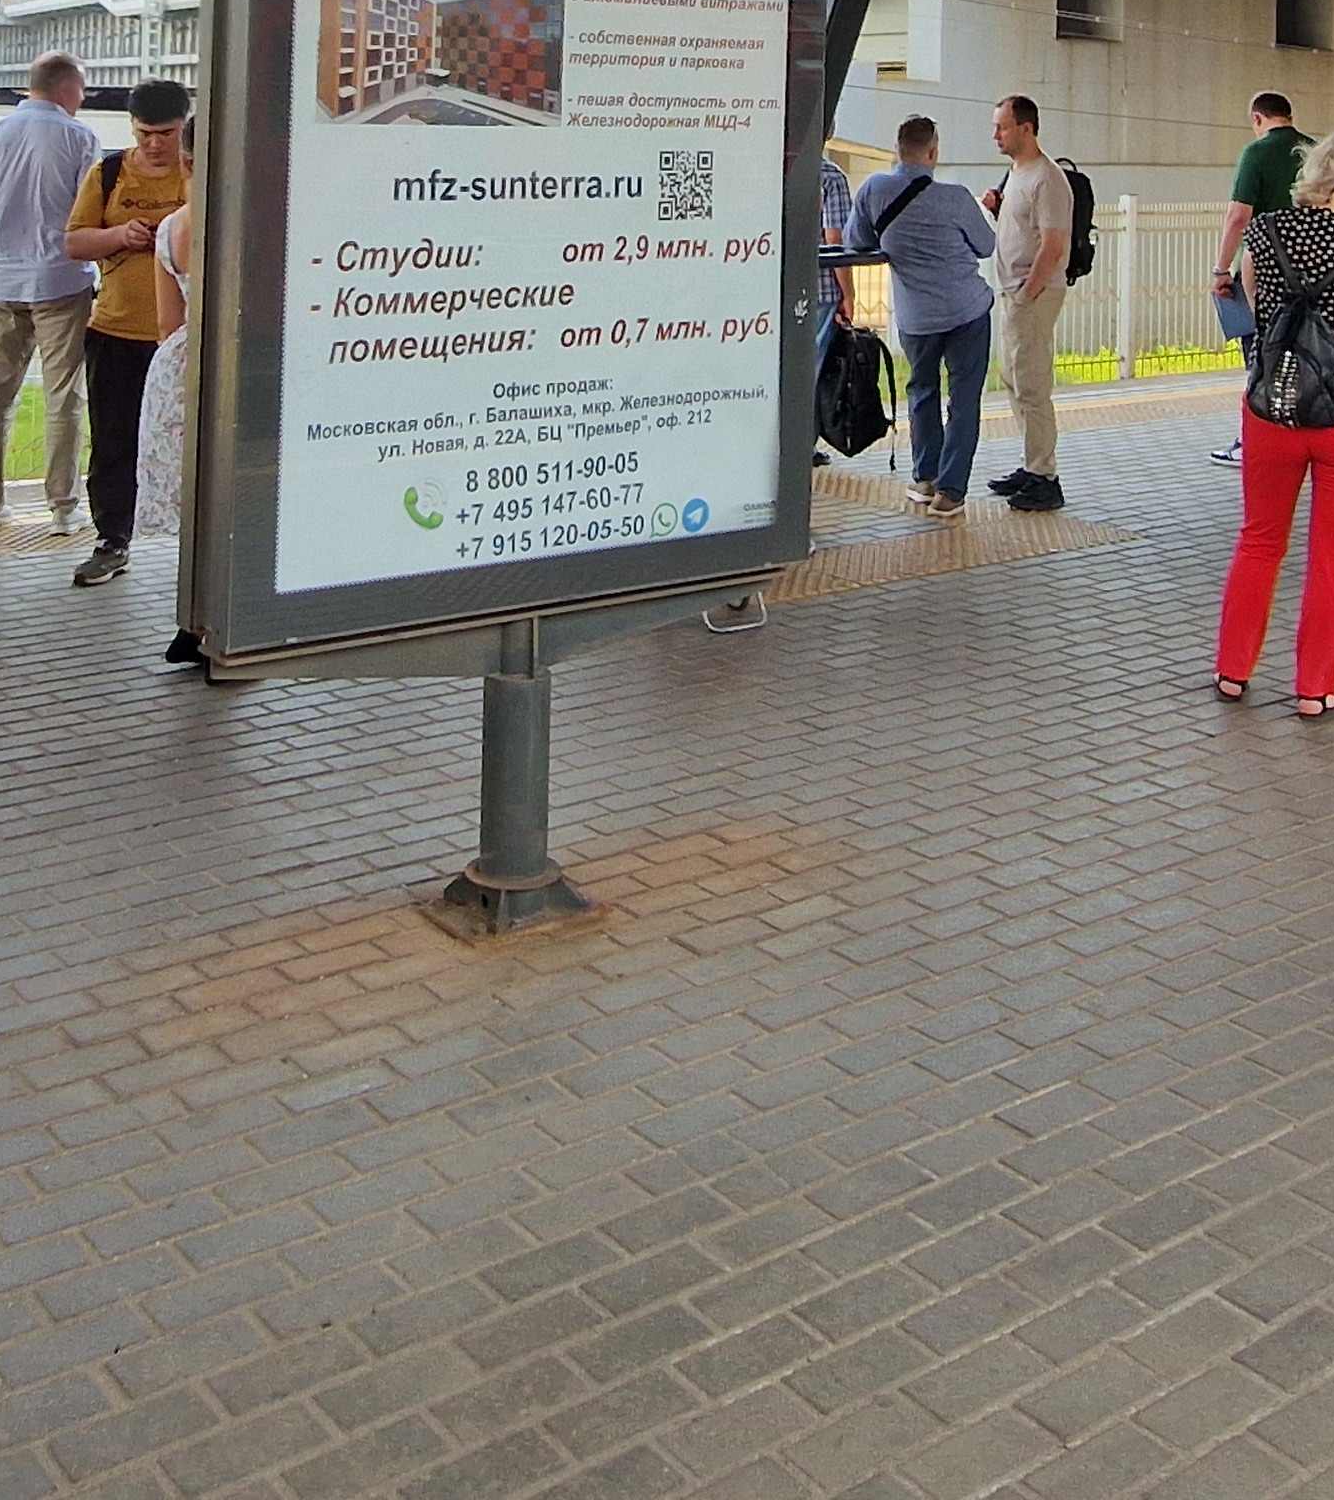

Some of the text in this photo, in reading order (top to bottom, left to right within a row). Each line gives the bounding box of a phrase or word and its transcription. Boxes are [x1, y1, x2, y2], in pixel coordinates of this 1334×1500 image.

[578, 29, 764, 51] собственная охраняемая
[569, 52, 745, 72] территория и парковка
[577, 92, 781, 111] пешая доступность от ст.
[566, 112, 752, 132] Железнодорожная МЦД-4
[393, 169, 643, 201] mfz-sunterra.ru
[336, 232, 776, 277] Студии: от 2,9 млн. руб.
[333, 283, 575, 320] Коммерческие
[329, 311, 774, 365] помещения: от 0,7 млн. руб.
[493, 377, 614, 401] Офис продаж:
[307, 385, 769, 442] Московская обл., г. Балашиха, мкр. Железнодорожный,
[378, 409, 712, 463] ул. Новая, д. 22А, БЦ "Премьер", оф. 212
[466, 451, 639, 493] 8 800 511-90-05
[456, 483, 644, 526] +7 495 147-60-77
[456, 515, 644, 560] +7 915 120-05-50
